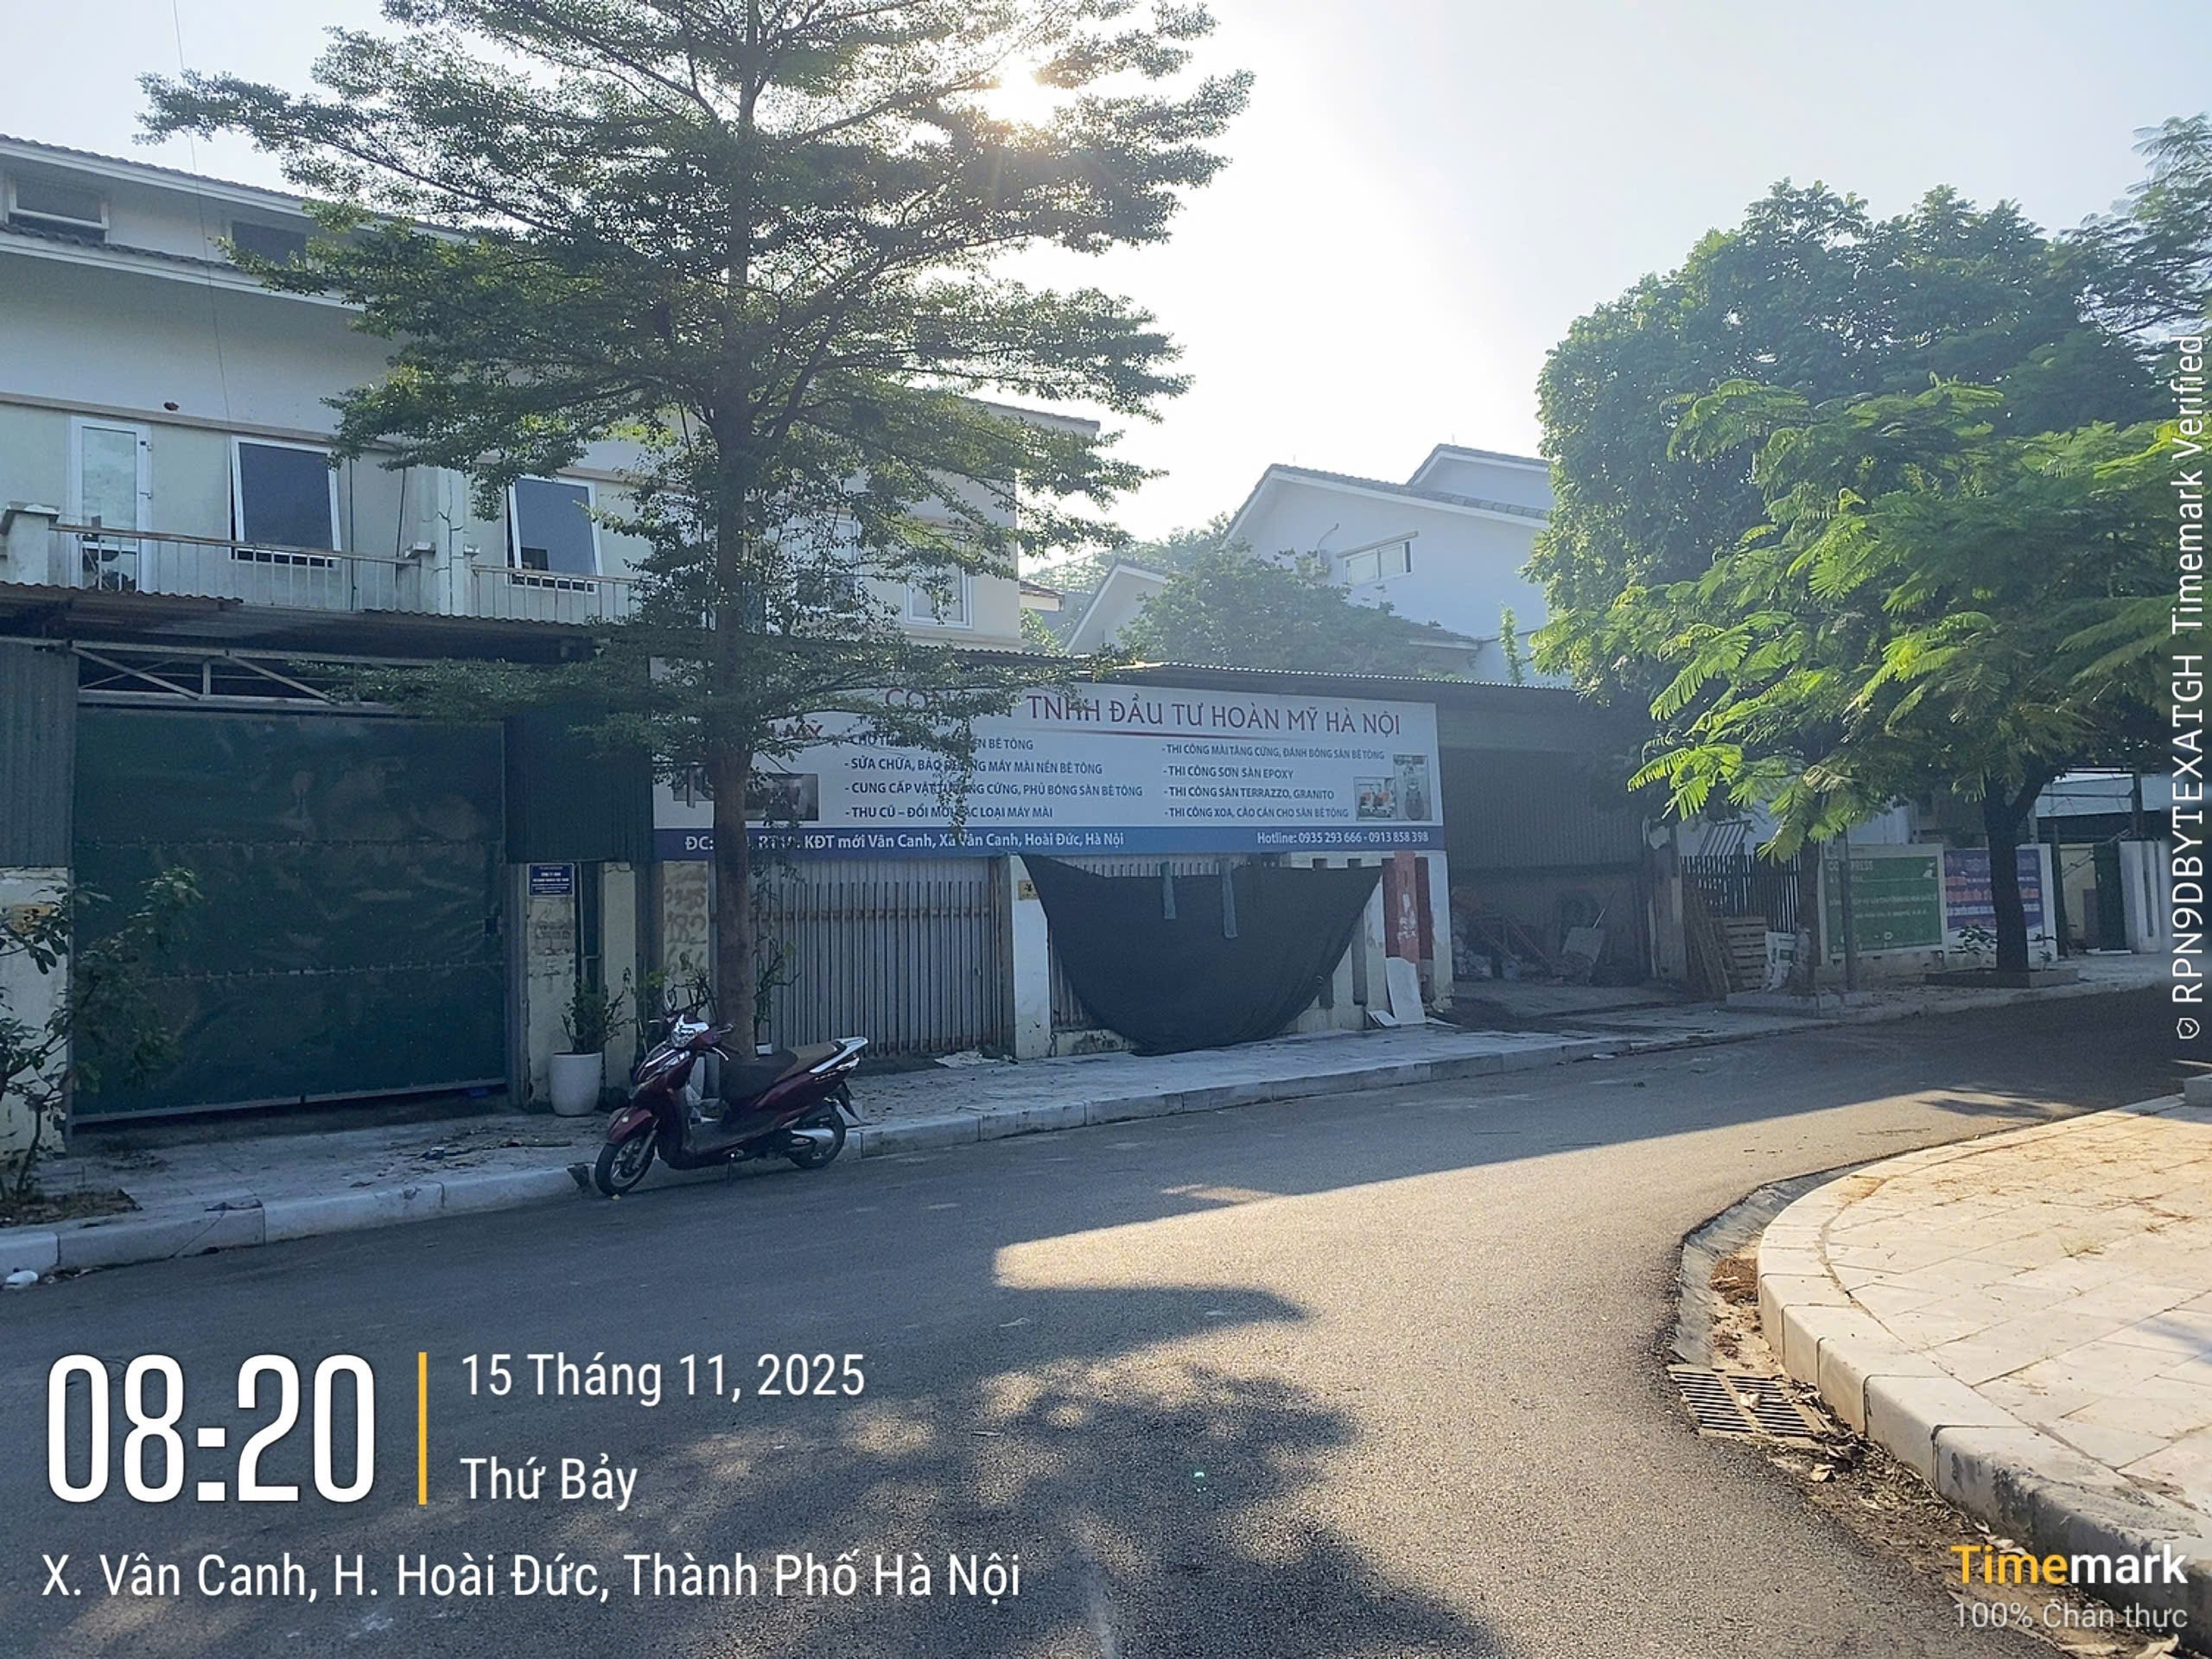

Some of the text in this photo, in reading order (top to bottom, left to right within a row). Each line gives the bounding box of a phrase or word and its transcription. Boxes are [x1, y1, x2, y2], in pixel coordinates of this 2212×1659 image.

[1027, 695, 1100, 721] TNHH
[1109, 692, 1163, 724] ĐẦU
[1172, 702, 1204, 726] TƯ
[1211, 702, 1280, 729] HOÀN
[1287, 706, 1318, 731] MỸ
[1326, 707, 1356, 733] HÀ
[1363, 710, 1399, 737] NỘI
[1004, 738, 1033, 750] TÔNG
[1166, 743, 1181, 754] THI
[1184, 743, 1210, 755] CÔNG
[851, 754, 876, 770] SỬA
[879, 757, 916, 772] CHỮA,
[918, 757, 942, 771] BẢO
[988, 759, 1011, 772] MÁY
[1014, 760, 1034, 773] MÀI
[1059, 761, 1073, 774] BÊ
[1074, 761, 1103, 775] TÔNG
[1168, 766, 1185, 777] THI
[1187, 765, 1217, 777] CÔNG
[1242, 764, 1262, 778] SÀN
[1263, 768, 1294, 779] EPOXY
[851, 782, 887, 793] CUNG
[888, 779, 912, 793] CẤP
[987, 781, 1021, 796] CỨNG,
[1023, 782, 1046, 795] PHỦ
[1047, 784, 1077, 796] BÓNG
[1079, 784, 1100, 796] SÀN
[1116, 785, 1142, 797] TÔNG
[1169, 786, 1186, 797] THI
[1188, 785, 1217, 798] CÔNG
[1219, 785, 1239, 798] SÀN
[1240, 787, 1292, 799] TERRAZZO,
[1294, 789, 1334, 799] GRANITO
[851, 806, 876, 817] THU
[879, 804, 895, 817] CŨ
[980, 807, 1005, 820] LOẠI
[1007, 806, 1029, 817] MÁY
[1033, 807, 1052, 817] MÀI
[1169, 807, 1185, 817] THI
[1186, 805, 1212, 818] CÔNG
[1276, 808, 1294, 818] CHO
[1326, 808, 1349, 819] TÔNG
[684, 836, 714, 851] ĐC:
[804, 835, 835, 849] KĐT
[838, 833, 865, 849] mới
[868, 834, 893, 849] Vân
[898, 833, 937, 849] Canh,
[987, 833, 1021, 848] Canh,
[1025, 832, 1052, 847] Hoài
[1056, 832, 1083, 848] Đức,
[1085, 832, 1102, 847] Hà
[1103, 832, 1123, 849] Nội
[1257, 831, 1297, 843] Hotline:
[1299, 832, 1323, 843] 0935
[1325, 832, 1342, 843] 293
[1344, 832, 1362, 843] 666
[1369, 831, 1392, 842] 0913
